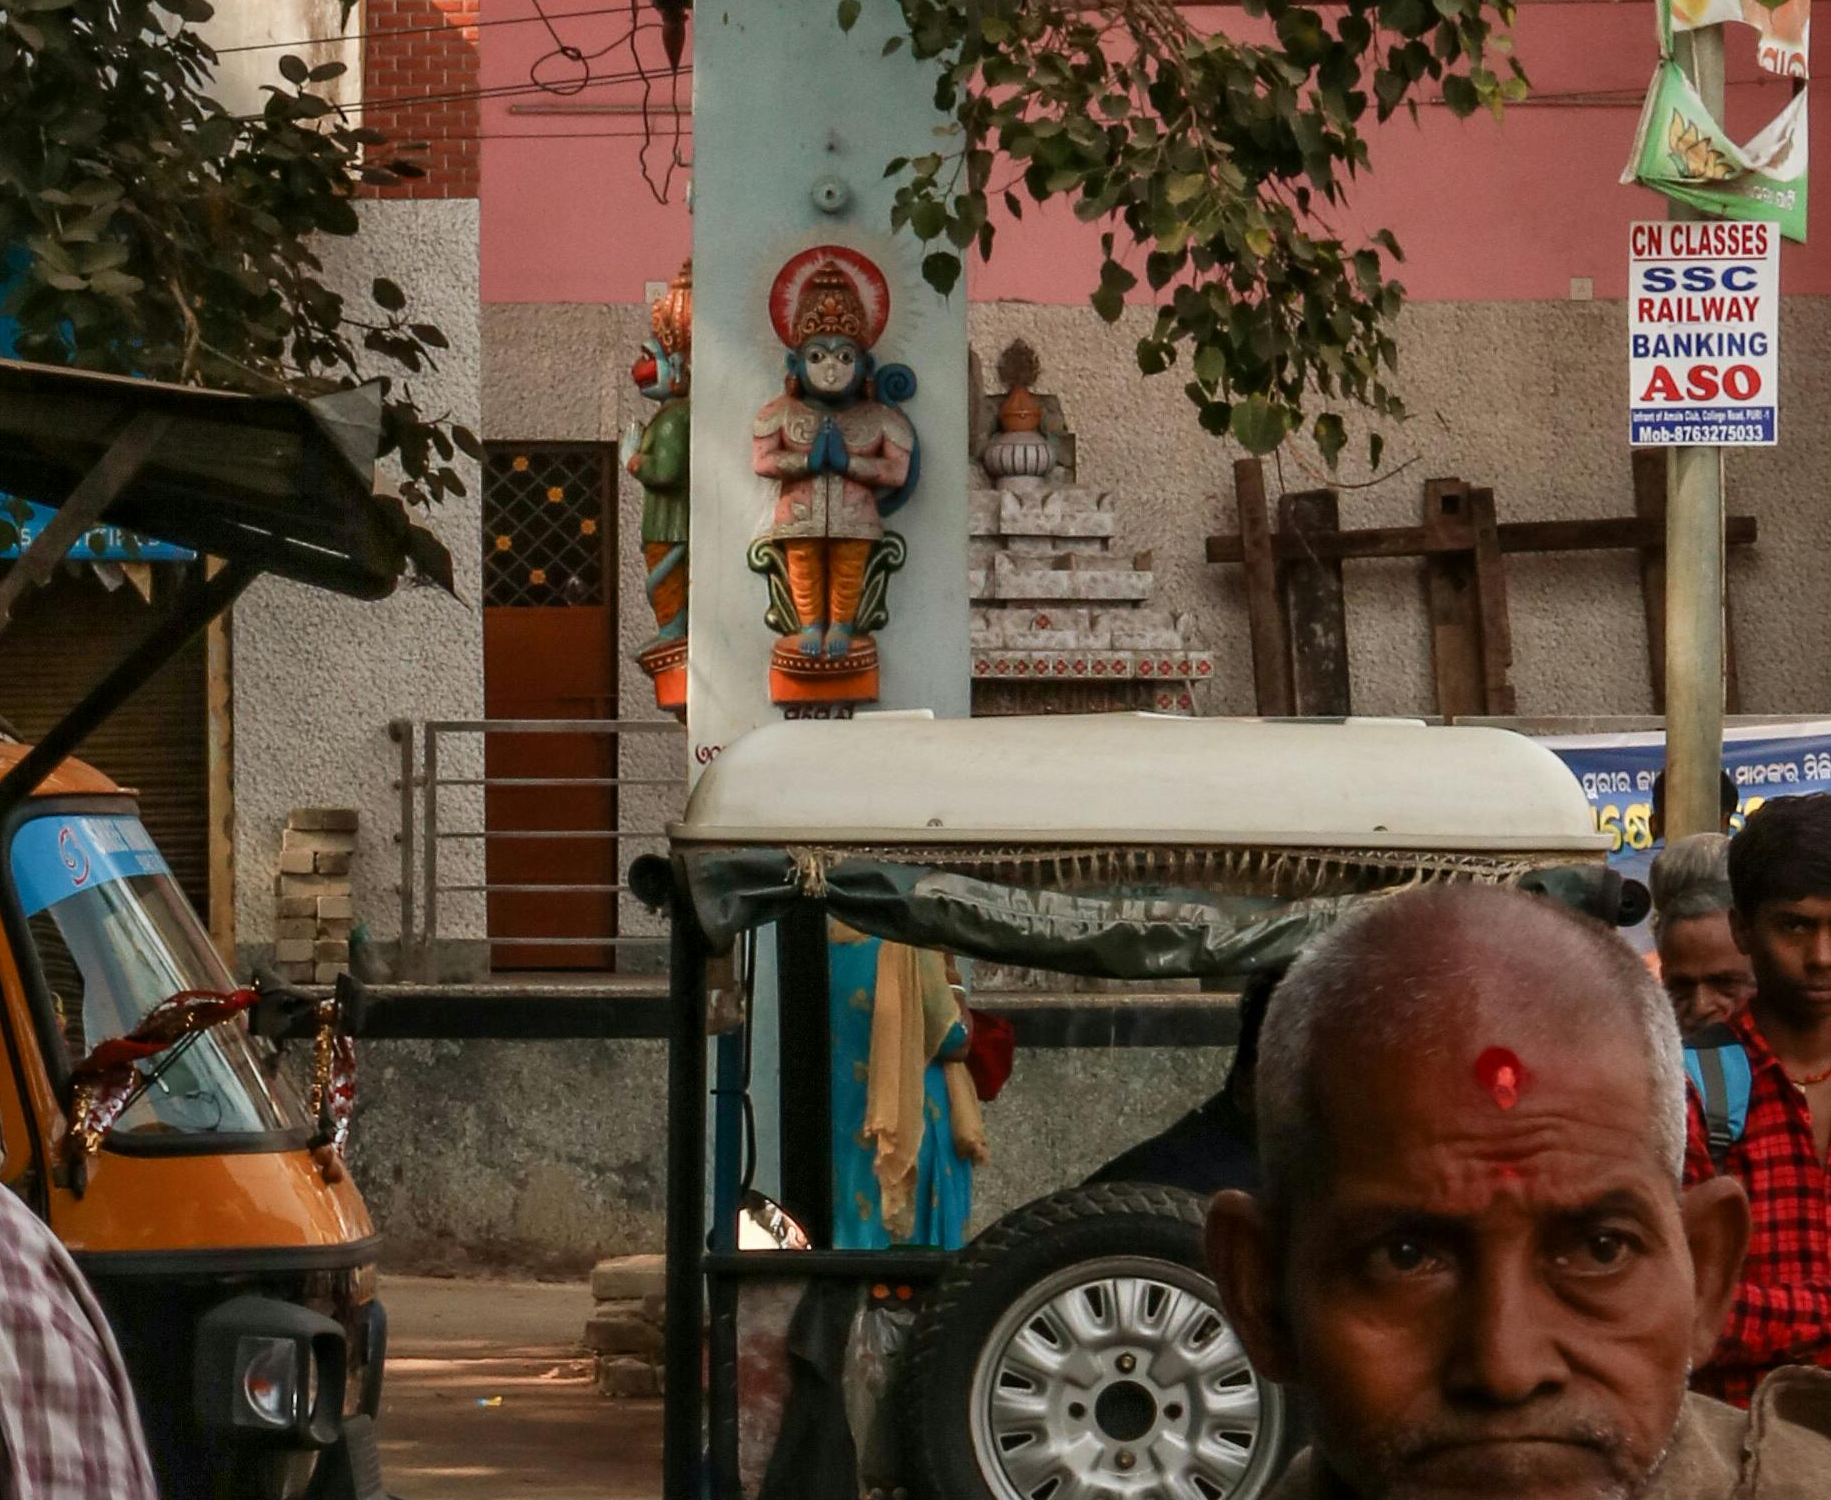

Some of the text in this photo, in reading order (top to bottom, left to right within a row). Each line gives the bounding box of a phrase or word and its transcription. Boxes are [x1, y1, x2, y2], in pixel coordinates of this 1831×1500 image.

[1632, 224, 1768, 257] CN CLASSES
[1642, 266, 1758, 293] SSC
[1638, 296, 1760, 323] RAILWAY
[1632, 332, 1768, 358] BANKING
[1640, 364, 1762, 401] ASO
[1639, 424, 1764, 442] Mob-8763275033
